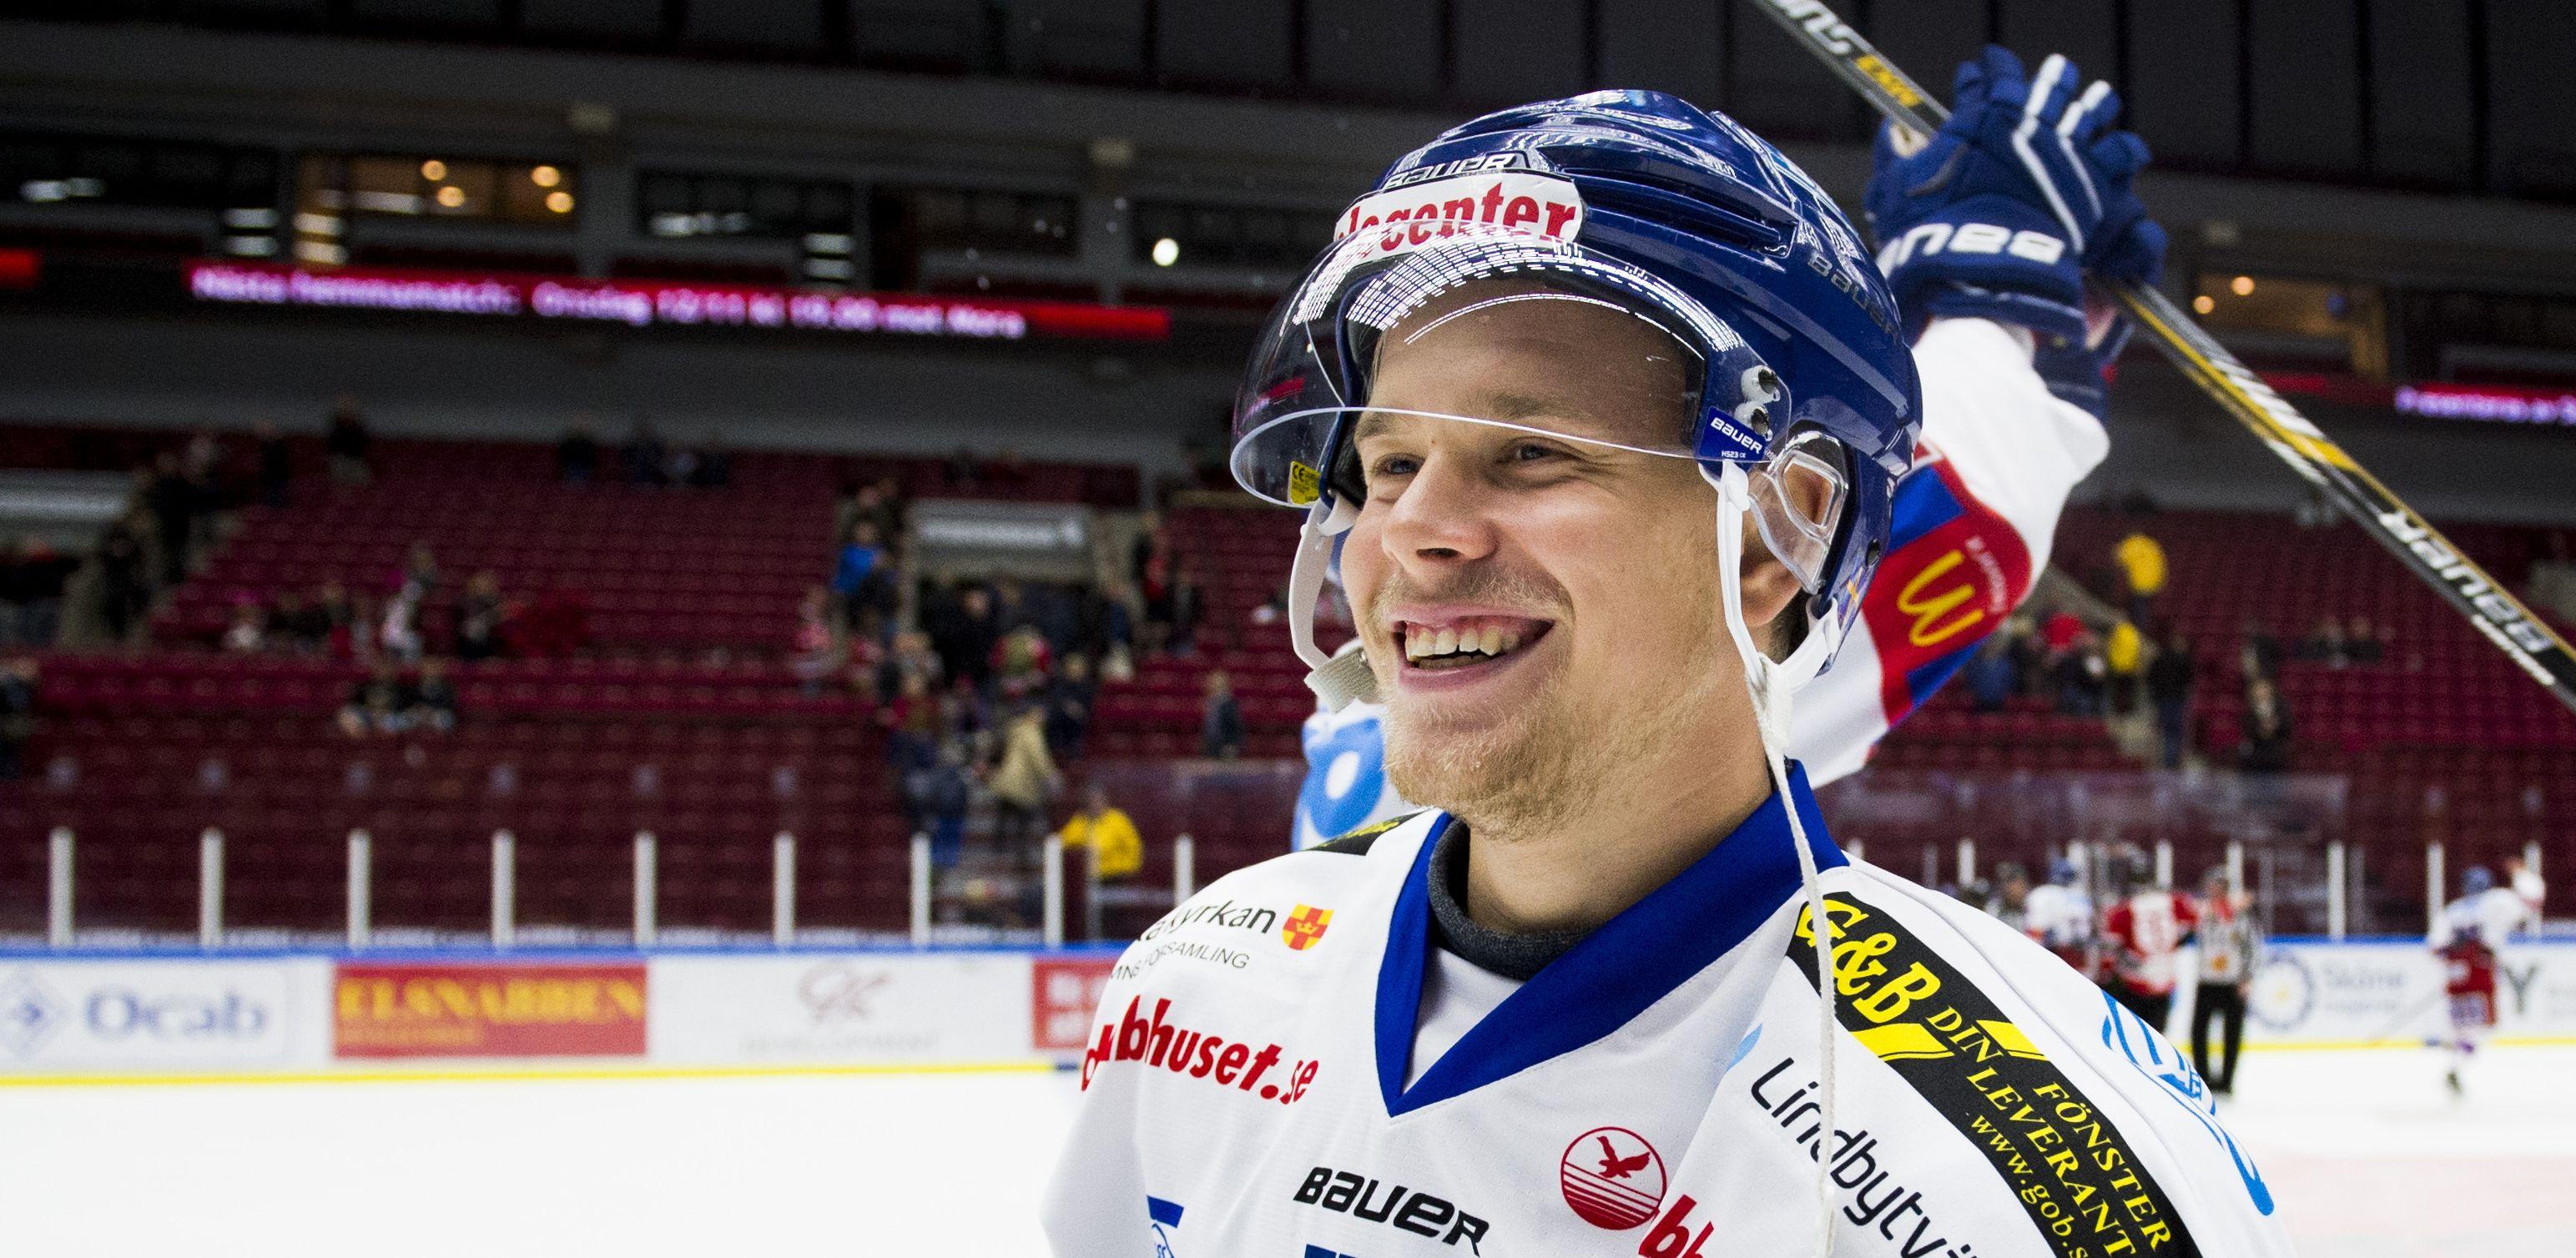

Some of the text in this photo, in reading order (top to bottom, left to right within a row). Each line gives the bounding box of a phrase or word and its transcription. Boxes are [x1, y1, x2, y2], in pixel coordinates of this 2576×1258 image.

[1711, 417, 1762, 455] BAUER
[2380, 510, 2555, 654] BAUER
[85, 983, 267, 1044] Ocab
[336, 978, 645, 1024] ELSNABBEN
[1927, 1005, 2004, 1063] DIN
[1967, 1067, 2137, 1256] LEVERANT
[2033, 1081, 2172, 1251] FÖNSTER
[1293, 1166, 1490, 1257] BAUER
